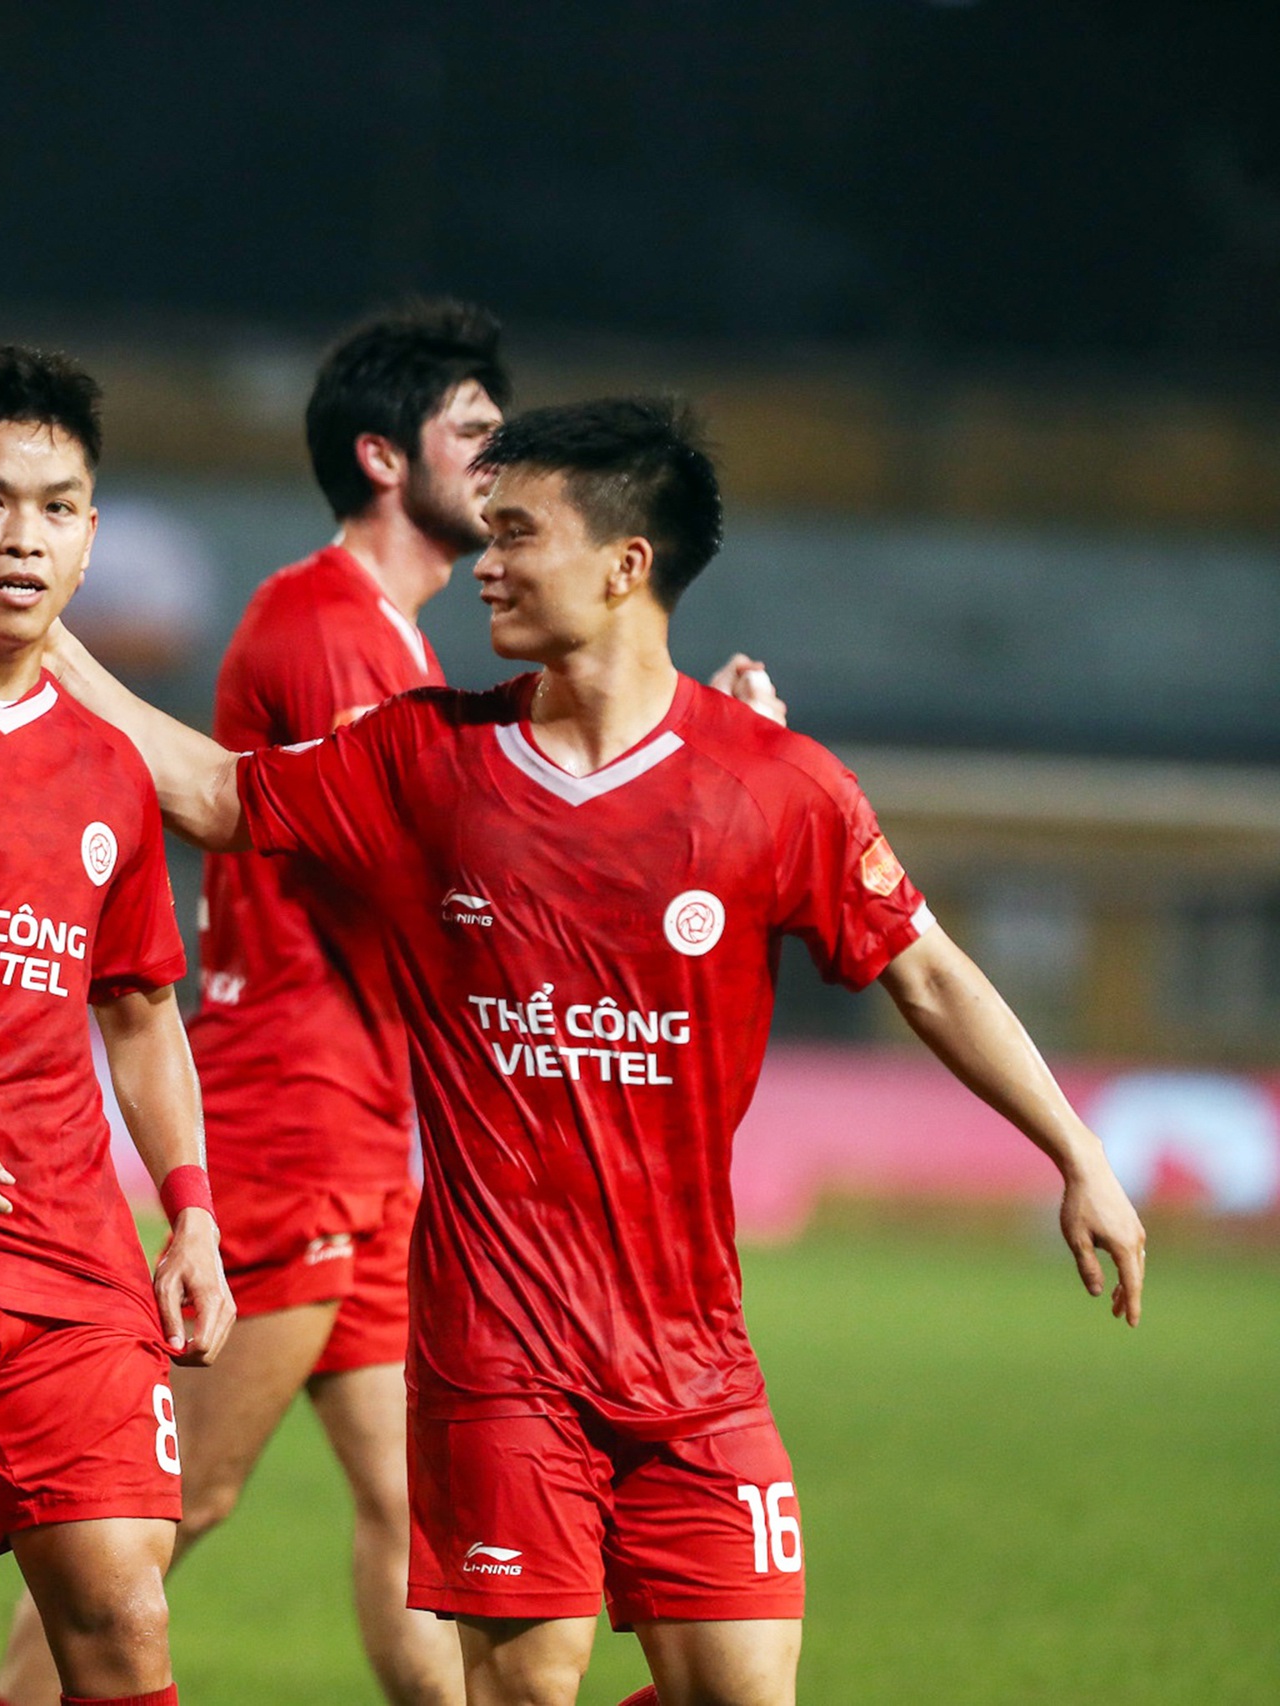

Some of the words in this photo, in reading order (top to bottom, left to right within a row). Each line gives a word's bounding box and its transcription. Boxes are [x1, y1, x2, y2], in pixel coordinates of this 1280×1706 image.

[468, 983, 557, 1036] THỂ
[565, 997, 690, 1045] CÔNG
[492, 1043, 673, 1085] VIETTEL
[152, 1383, 182, 1475] 8
[737, 1481, 803, 1574] 16
[463, 1561, 522, 1575] LI-NING
